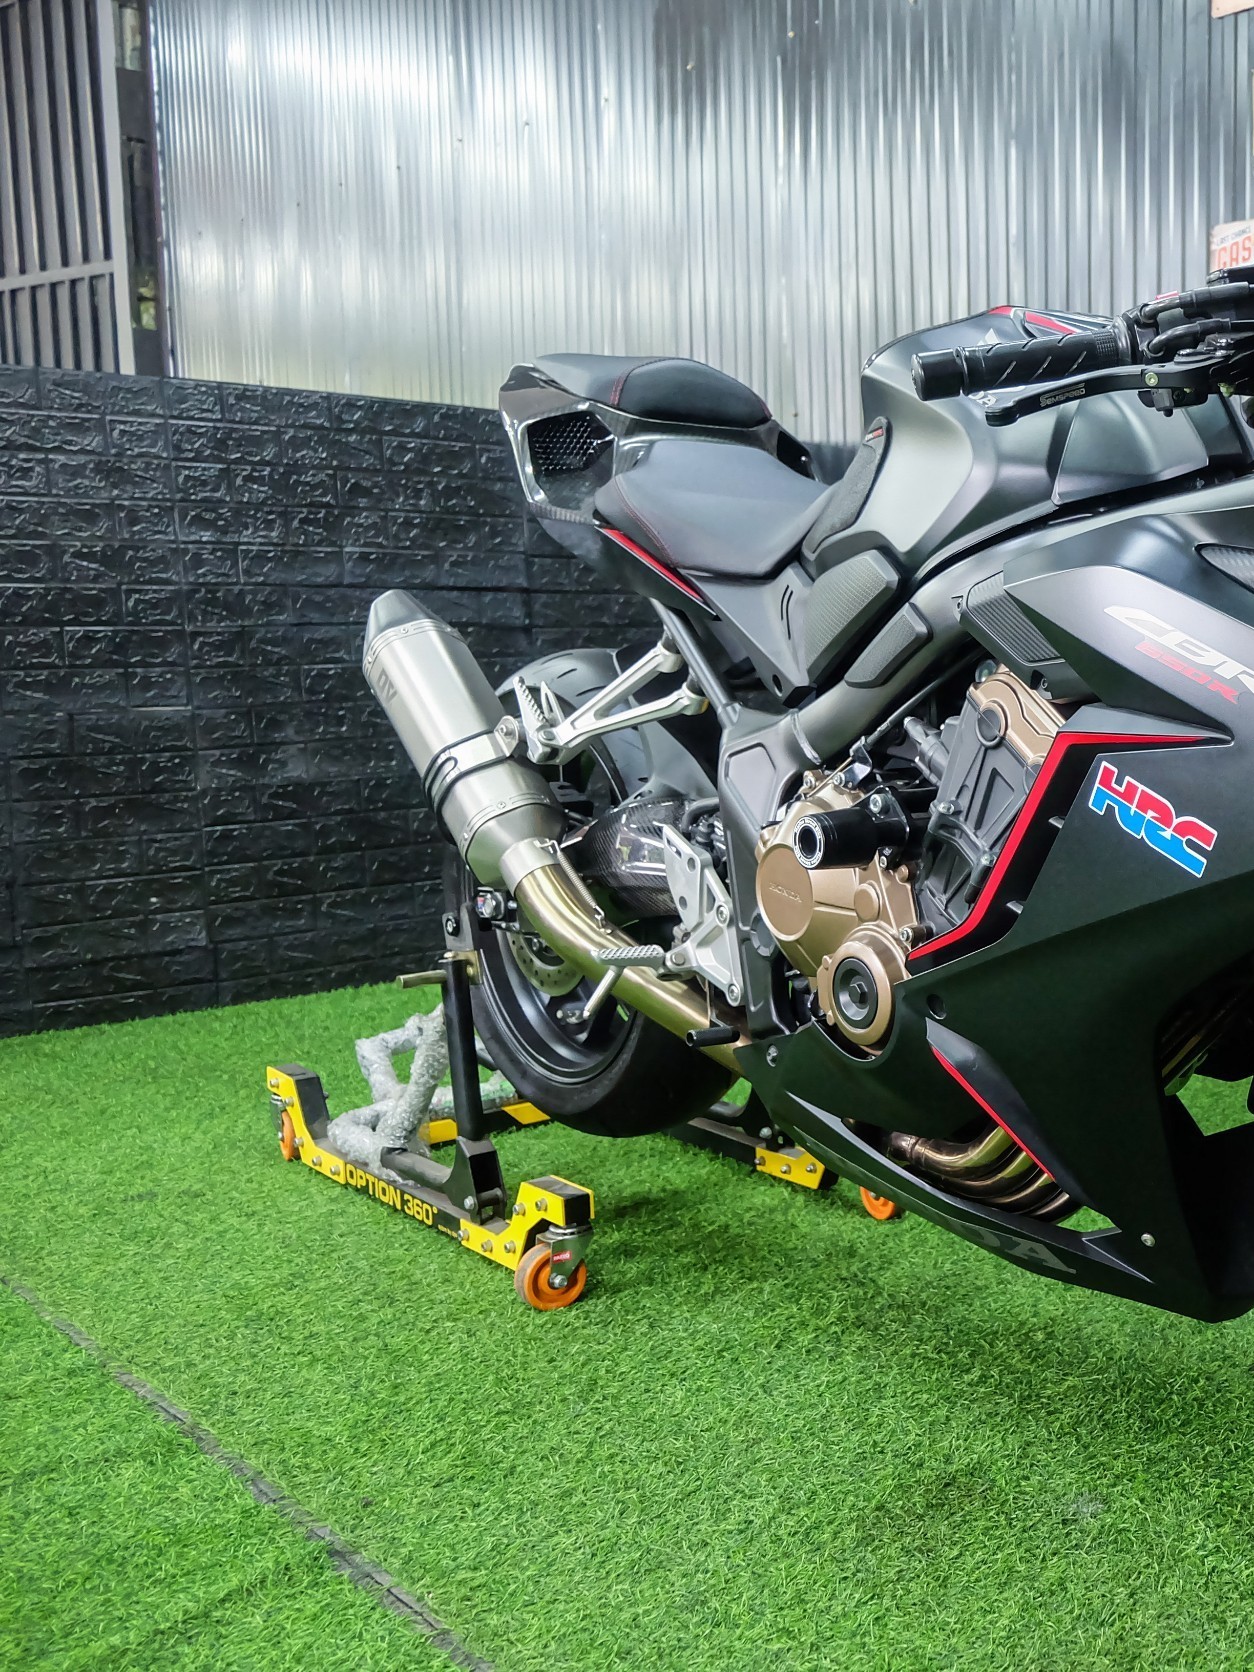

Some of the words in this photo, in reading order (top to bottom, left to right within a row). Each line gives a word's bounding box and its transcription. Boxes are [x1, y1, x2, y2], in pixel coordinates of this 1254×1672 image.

[1135, 641, 1238, 705] 650R
[1088, 760, 1218, 878] HRC
[769, 882, 802, 903] HONDA
[346, 1163, 402, 1211] OPTION
